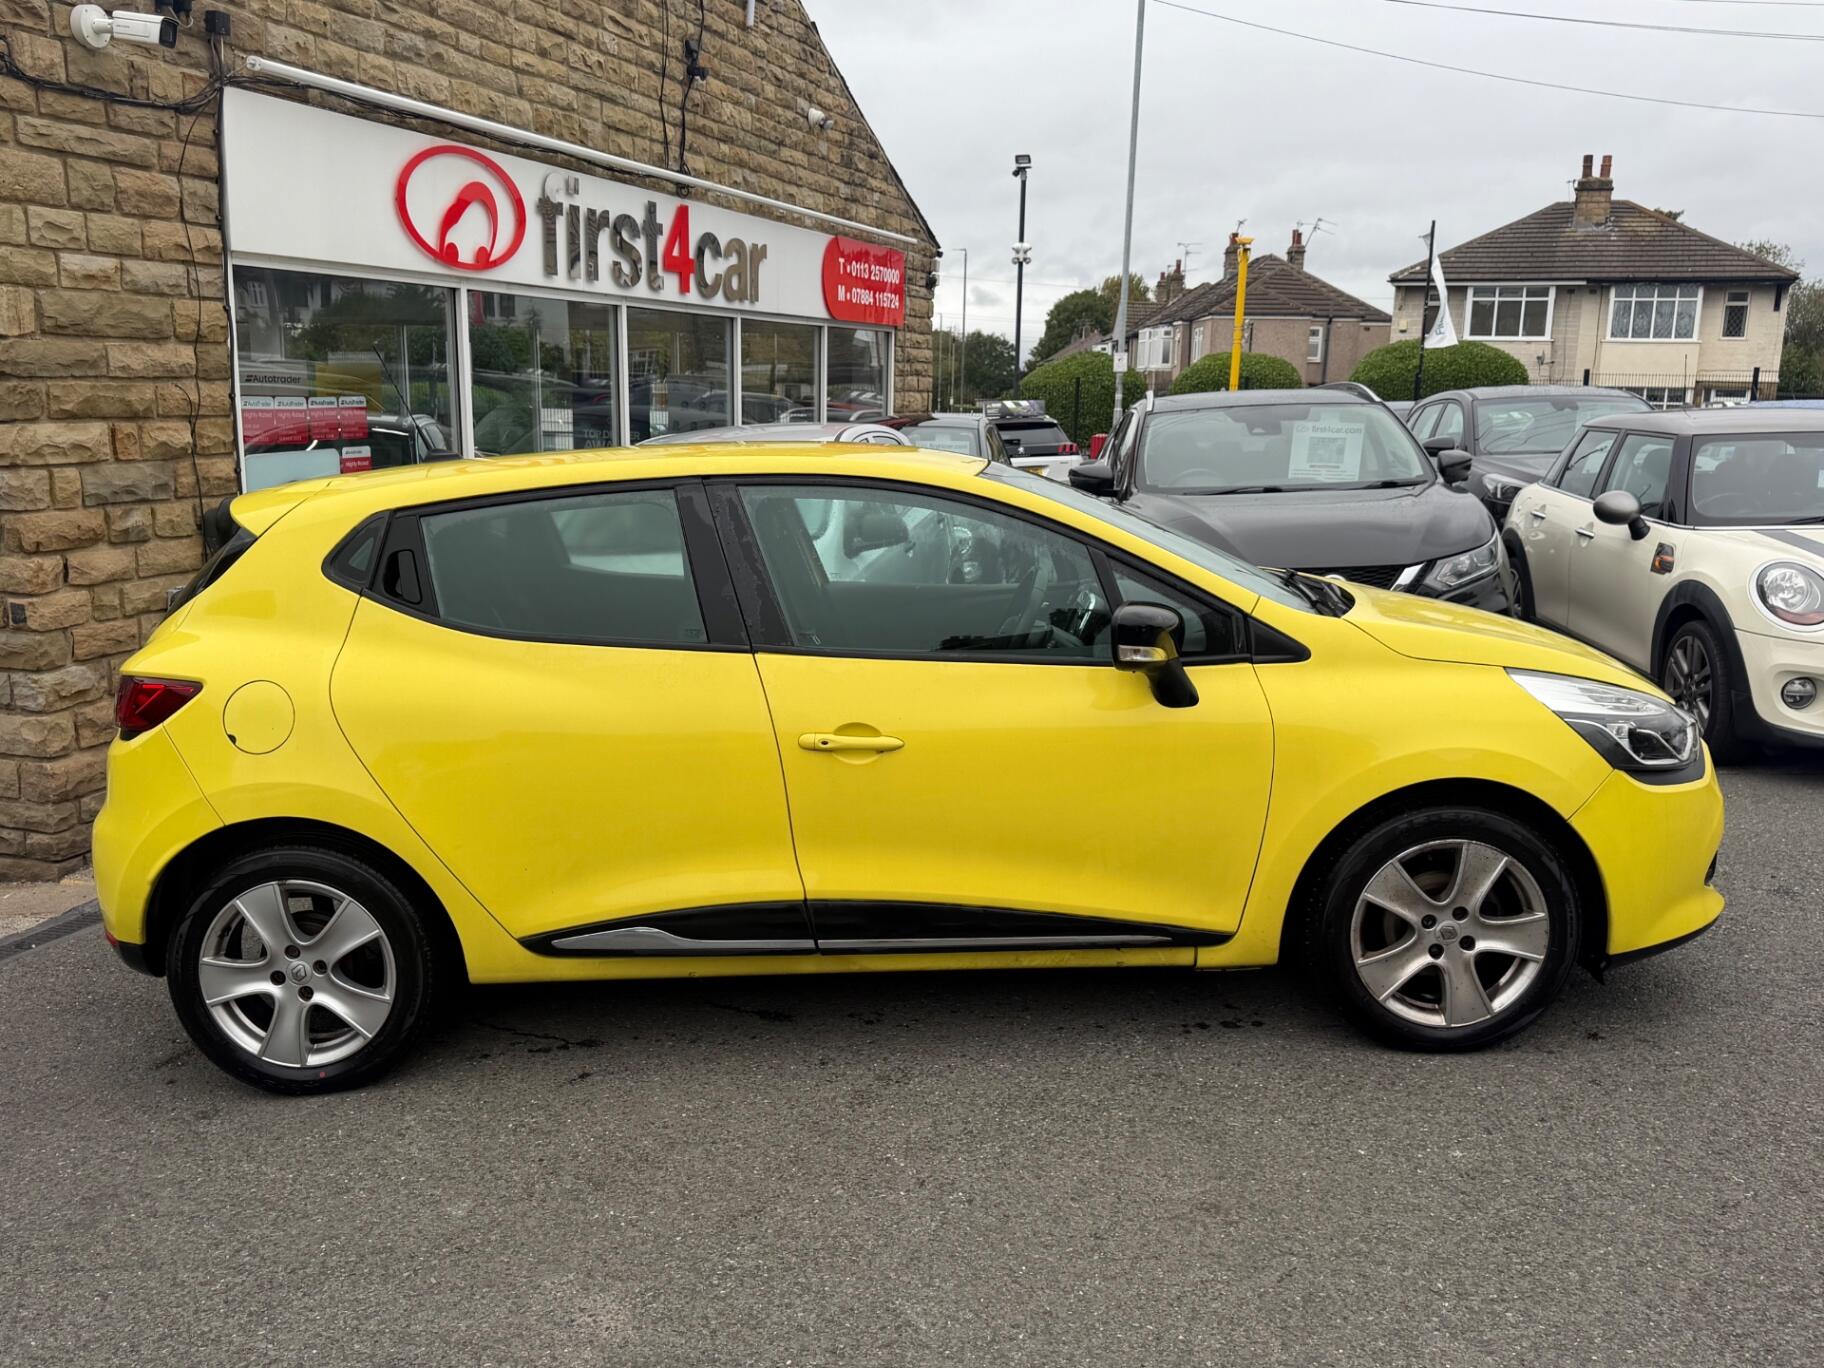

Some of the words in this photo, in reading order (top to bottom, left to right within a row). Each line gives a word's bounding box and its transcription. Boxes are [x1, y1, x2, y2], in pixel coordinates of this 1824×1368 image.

[537, 172, 767, 303] first4car
[838, 257, 845, 275] T
[851, 260, 869, 279] 0113
[870, 264, 900, 284] 2570000
[837, 284, 846, 301] M
[875, 291, 900, 309] 115724
[252, 374, 301, 384] Autotrader
